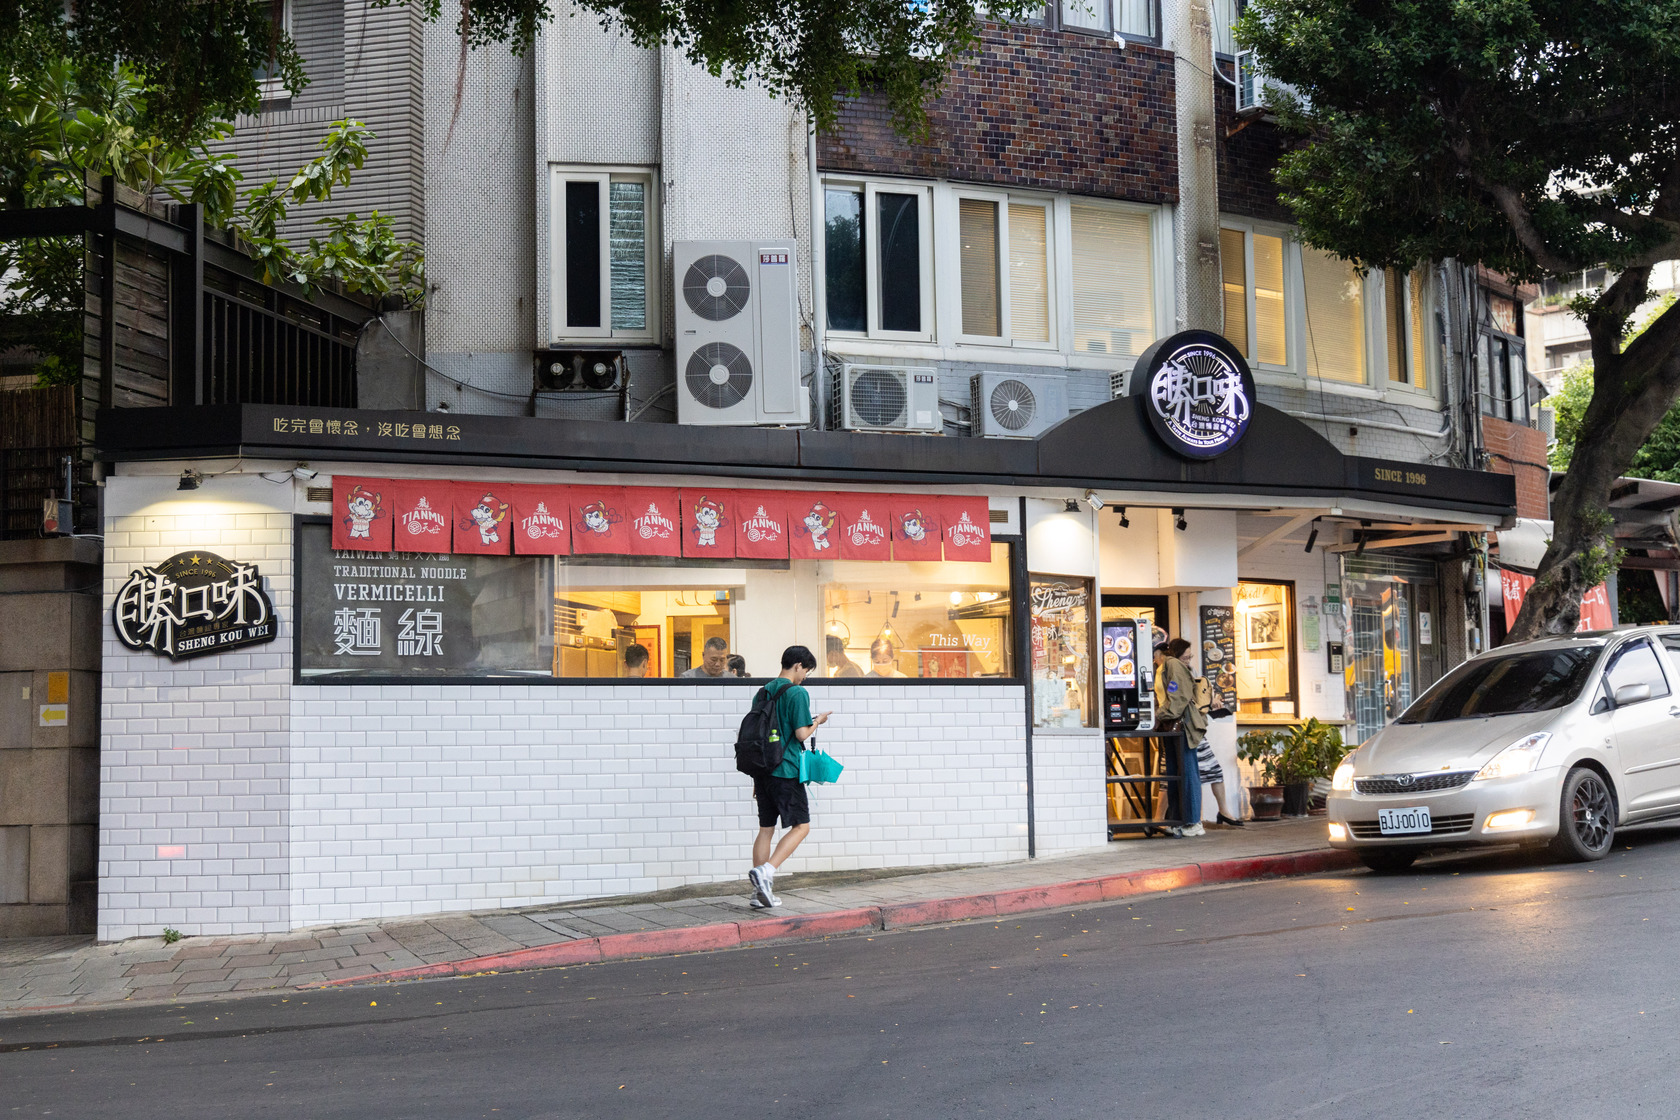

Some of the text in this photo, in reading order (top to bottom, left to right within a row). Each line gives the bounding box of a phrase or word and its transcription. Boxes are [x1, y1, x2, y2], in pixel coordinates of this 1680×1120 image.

[1203, 350, 1217, 359] 1996
[1191, 413, 1210, 422] SHENG
[1225, 418, 1237, 429] WEI
[1374, 467, 1427, 486] SINCE 1996
[402, 510, 445, 527] TIANMU
[521, 514, 564, 531] TIANMU
[633, 515, 674, 532] TIANMU
[742, 518, 782, 534] TIANMU
[847, 522, 885, 538] TIANMU
[947, 523, 985, 539] TIANMU
[334, 549, 383, 560] TAIWAN
[175, 569, 216, 580] SINCE 1996
[334, 565, 467, 580] TRADITIONAL NOODLE
[334, 583, 445, 602] VERMICELLI
[1031, 587, 1078, 617] Sheng
[178, 624, 270, 652] SHENG KOU WEI
[929, 633, 991, 650] This Way
[1380, 813, 1430, 830] BJJ-0010
